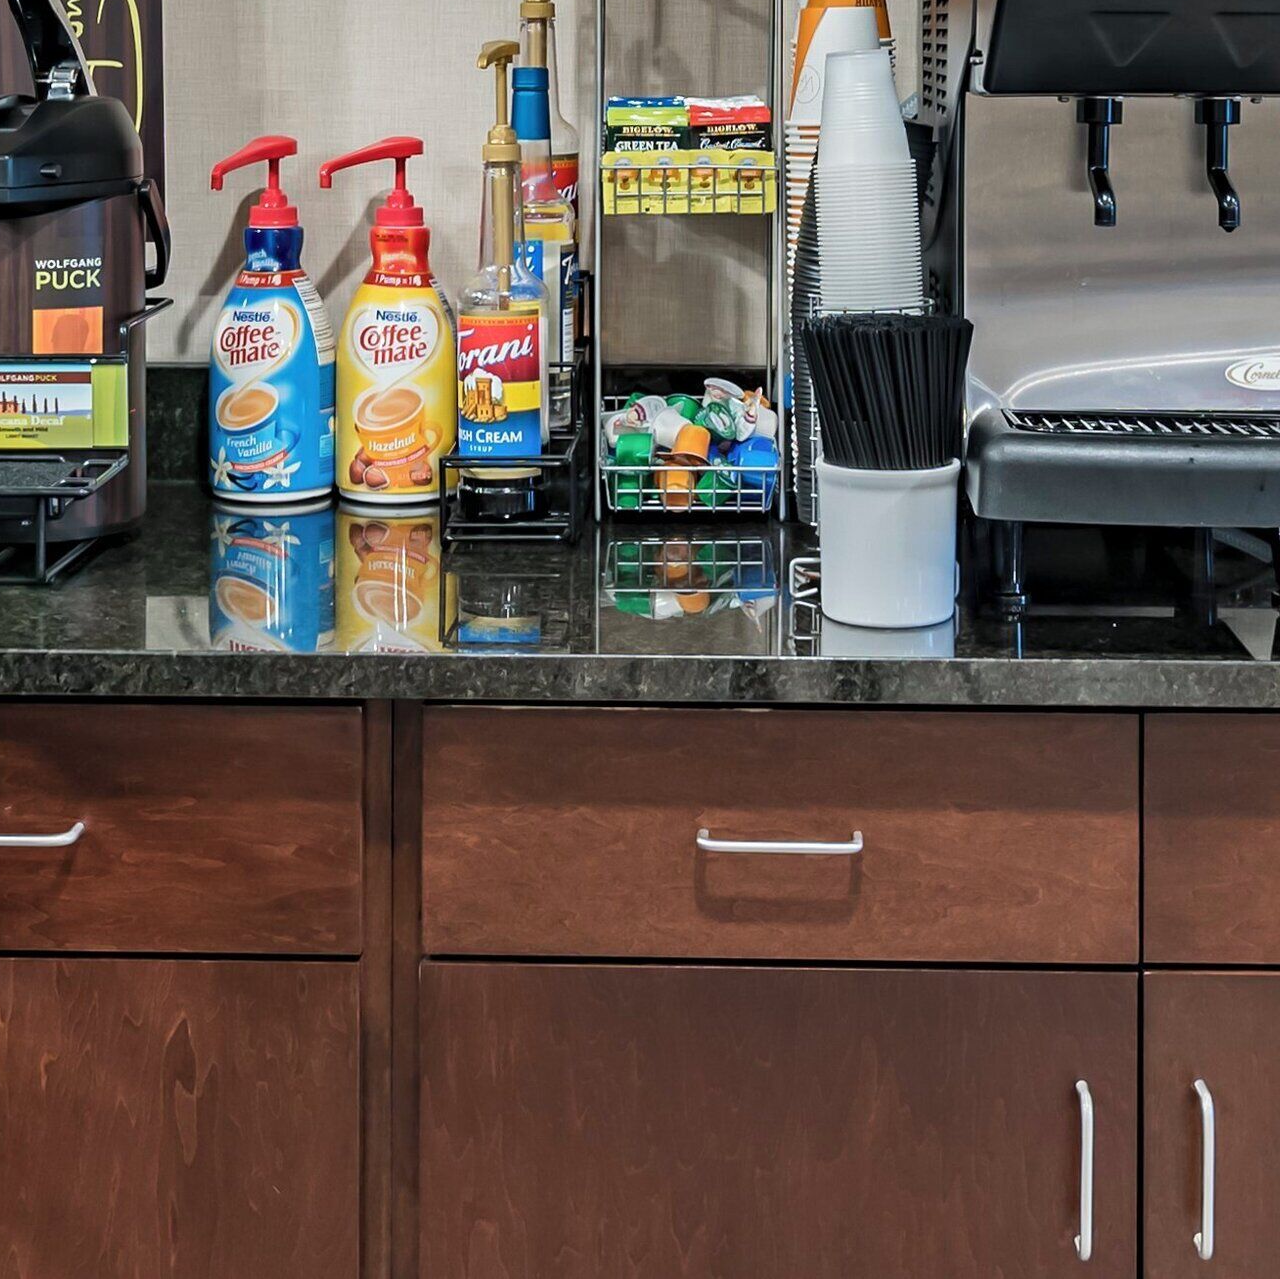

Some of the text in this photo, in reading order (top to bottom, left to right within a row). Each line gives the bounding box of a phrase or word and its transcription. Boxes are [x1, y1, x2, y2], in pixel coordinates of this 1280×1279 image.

[616, 140, 678, 151] GREEN TEA
[35, 257, 102, 270] WOLFGANG
[35, 269, 101, 291] PUCK
[230, 342, 280, 366] mate
[374, 341, 427, 365] mate
[30, 414, 66, 426] Decaf
[227, 435, 257, 448] French
[368, 433, 416, 452] Hazelnut
[476, 428, 523, 444] CREAM
[238, 440, 272, 457] Vanilla
